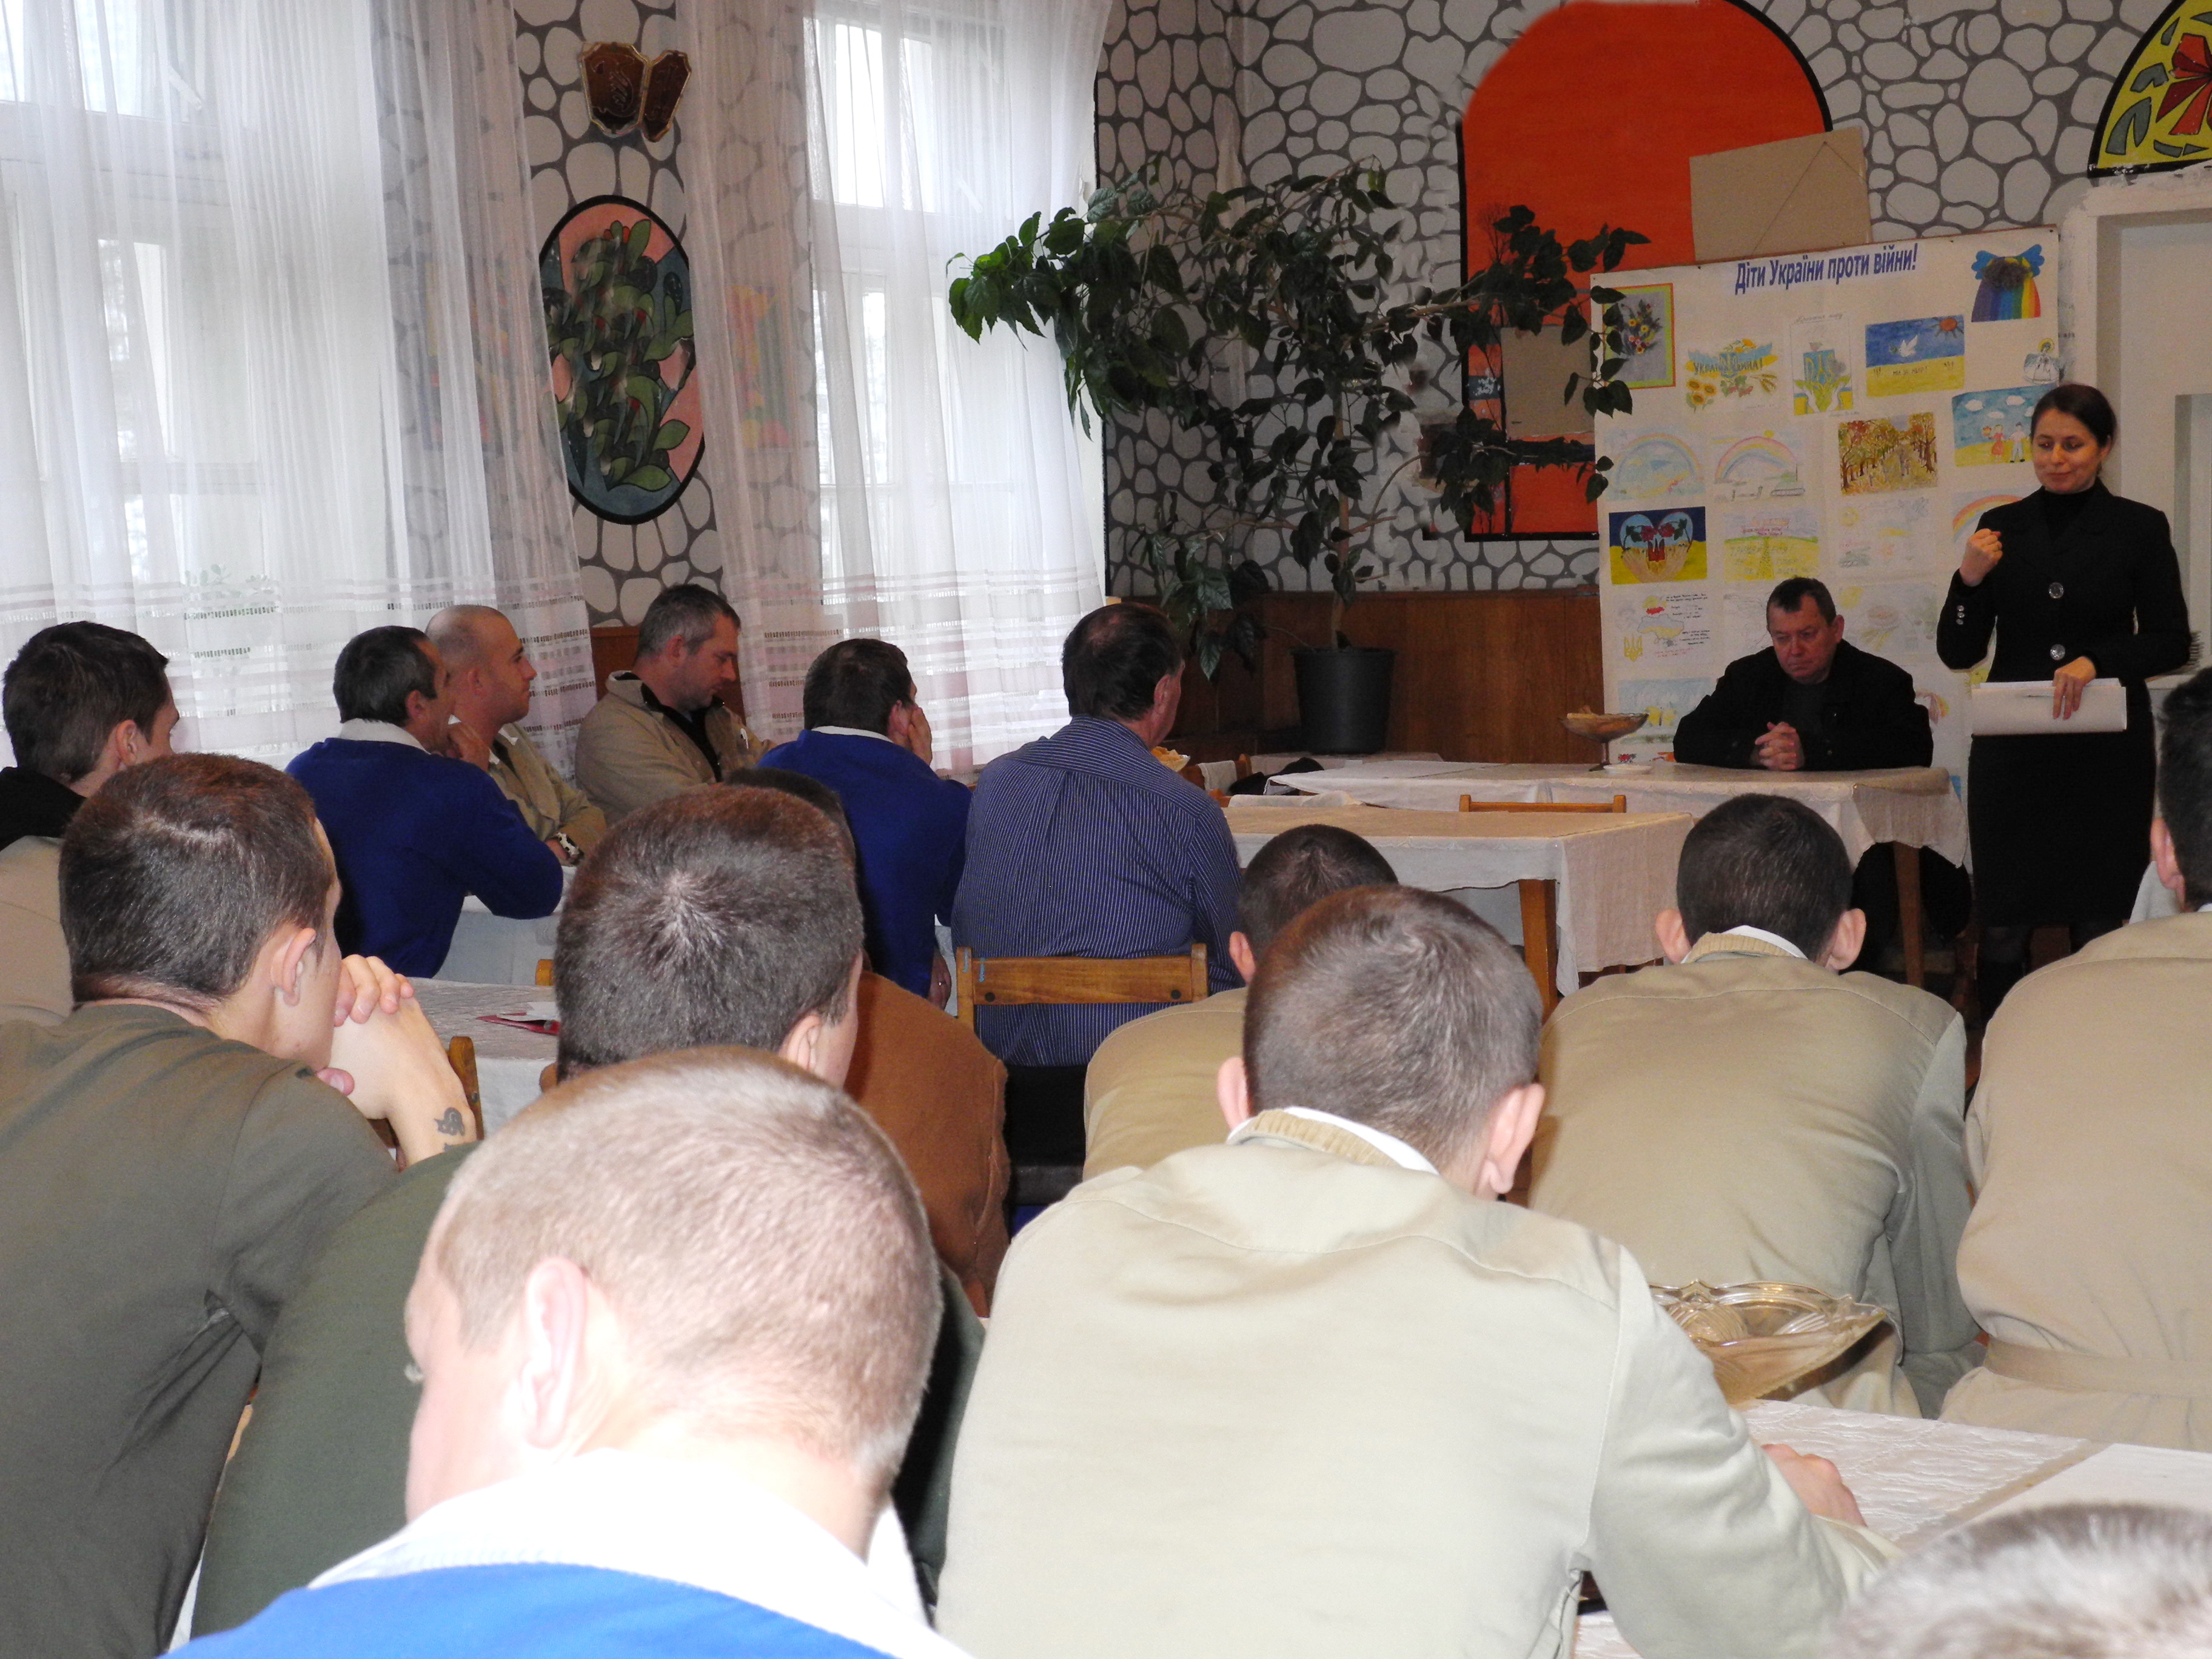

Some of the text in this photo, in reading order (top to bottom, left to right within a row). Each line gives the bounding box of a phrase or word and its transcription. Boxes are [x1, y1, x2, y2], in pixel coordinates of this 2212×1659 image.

[1735, 243, 1918, 295] Діти України проти війни!
